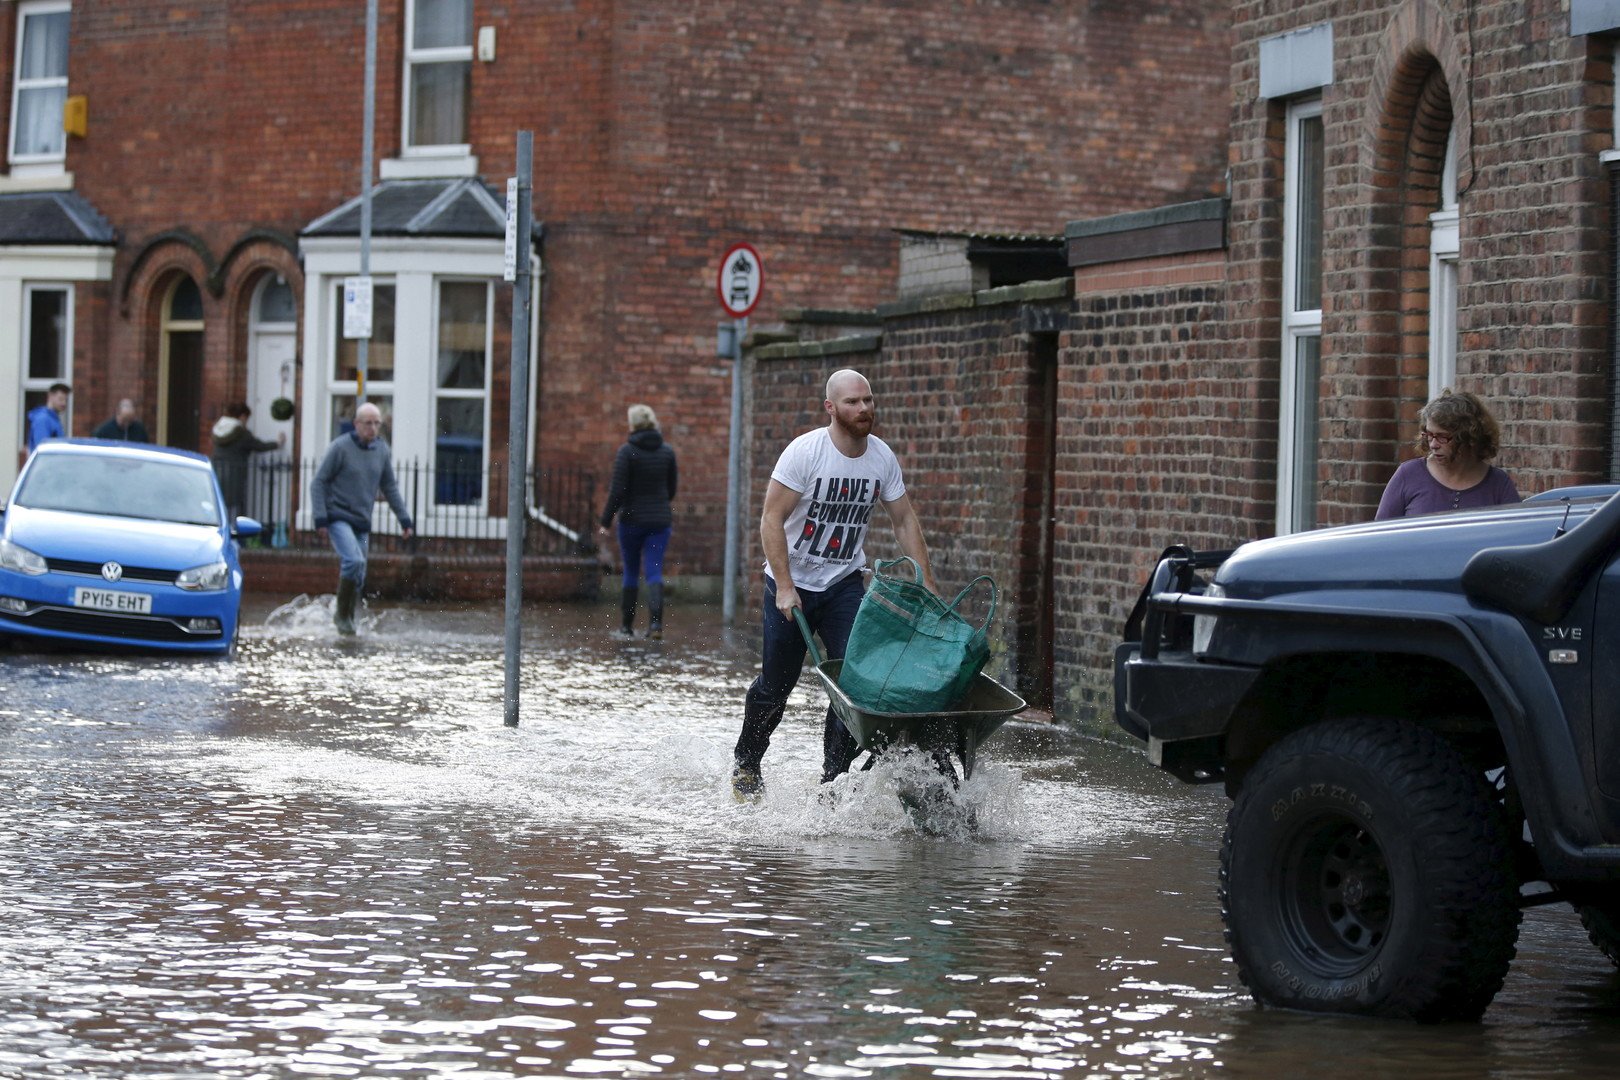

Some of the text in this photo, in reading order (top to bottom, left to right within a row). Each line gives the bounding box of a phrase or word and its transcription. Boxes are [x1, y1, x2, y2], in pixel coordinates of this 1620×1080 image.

[812, 478, 881, 503] I HAVE A
[81, 591, 147, 611] PY15 EHT
[1543, 627, 1582, 640] SVE
